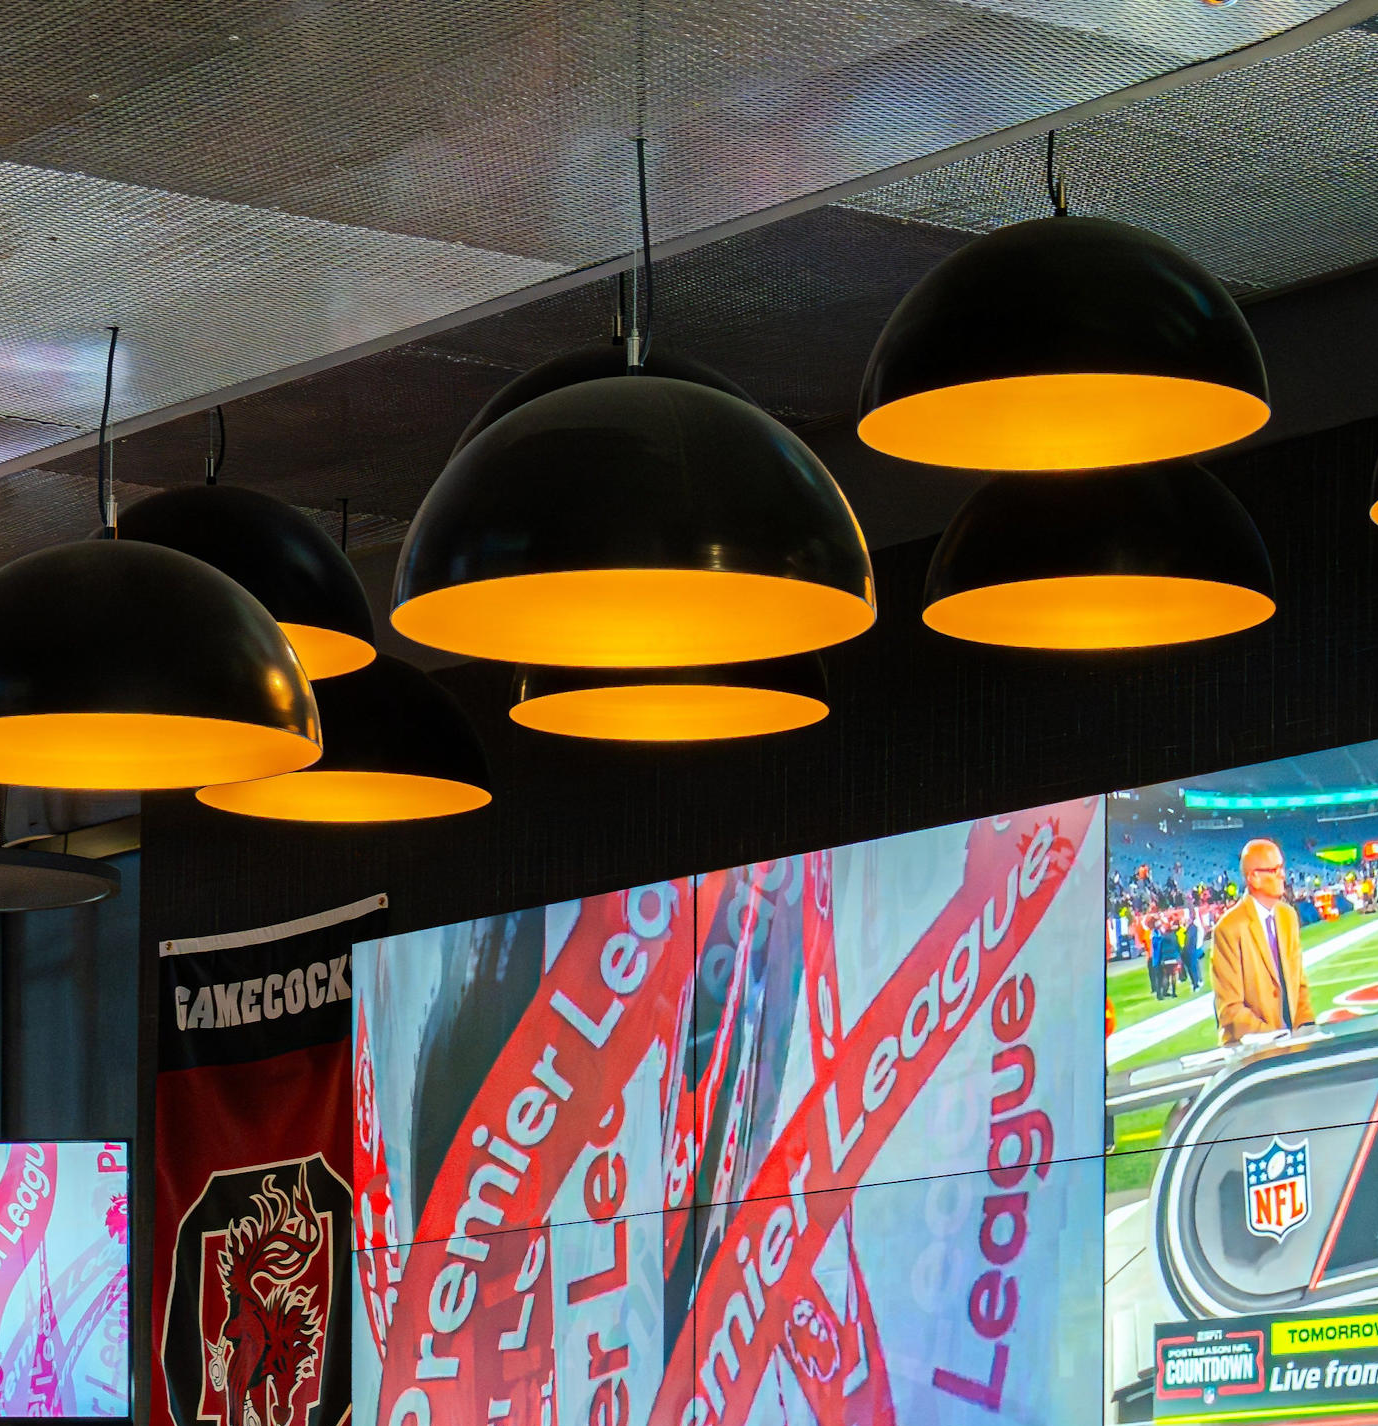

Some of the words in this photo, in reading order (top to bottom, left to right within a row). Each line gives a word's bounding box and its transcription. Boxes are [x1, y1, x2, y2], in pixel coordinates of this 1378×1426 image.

[175, 953, 352, 1031] GAMECOCK
[824, 822, 1058, 1173] League
[931, 970, 1054, 1412] League
[1253, 1187, 1304, 1229] NFL
[1166, 1353, 1253, 1385] COUNTDOWN
[1168, 1344, 1231, 1359] POSTSEASON
[1232, 1343, 1251, 1354] NFL
[1269, 1361, 1321, 1393] Live
